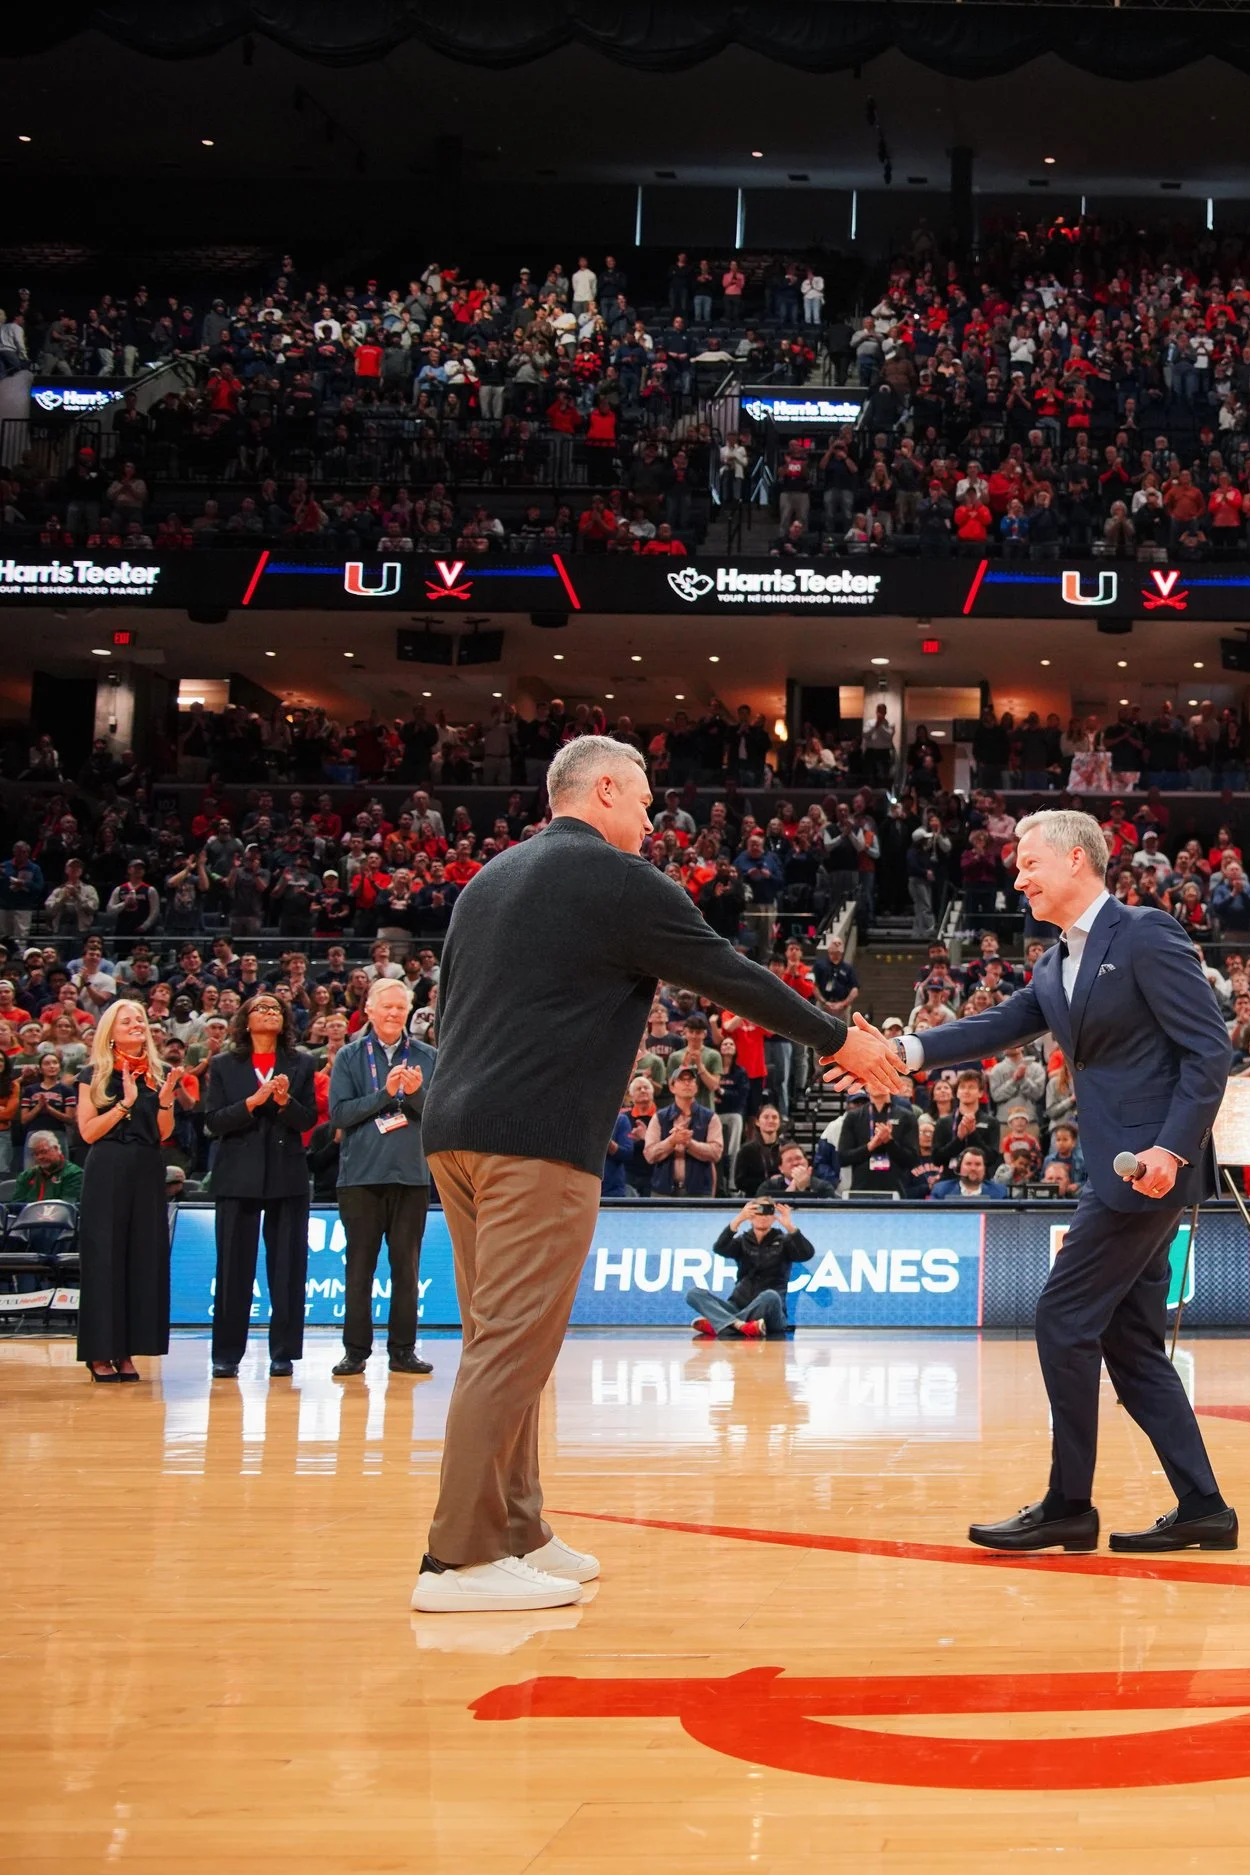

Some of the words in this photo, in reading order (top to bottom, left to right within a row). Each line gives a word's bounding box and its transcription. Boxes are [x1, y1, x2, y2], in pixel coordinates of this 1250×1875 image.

[0, 560, 74, 583] Harris
[73, 560, 160, 585] Teeter
[344, 561, 402, 597] U
[716, 568, 796, 592] Harris
[795, 569, 881, 594] Teeter
[0, 586, 21, 594] OUR
[24, 586, 108, 595] NEIGHBORHOOD
[110, 587, 153, 595] MARKET
[717, 594, 745, 603] YOUR
[747, 594, 831, 604] NEIGHBORHOOD
[832, 595, 875, 604] MARKET
[1061, 570, 1118, 606] U
[593, 1247, 960, 1293] HURANES
